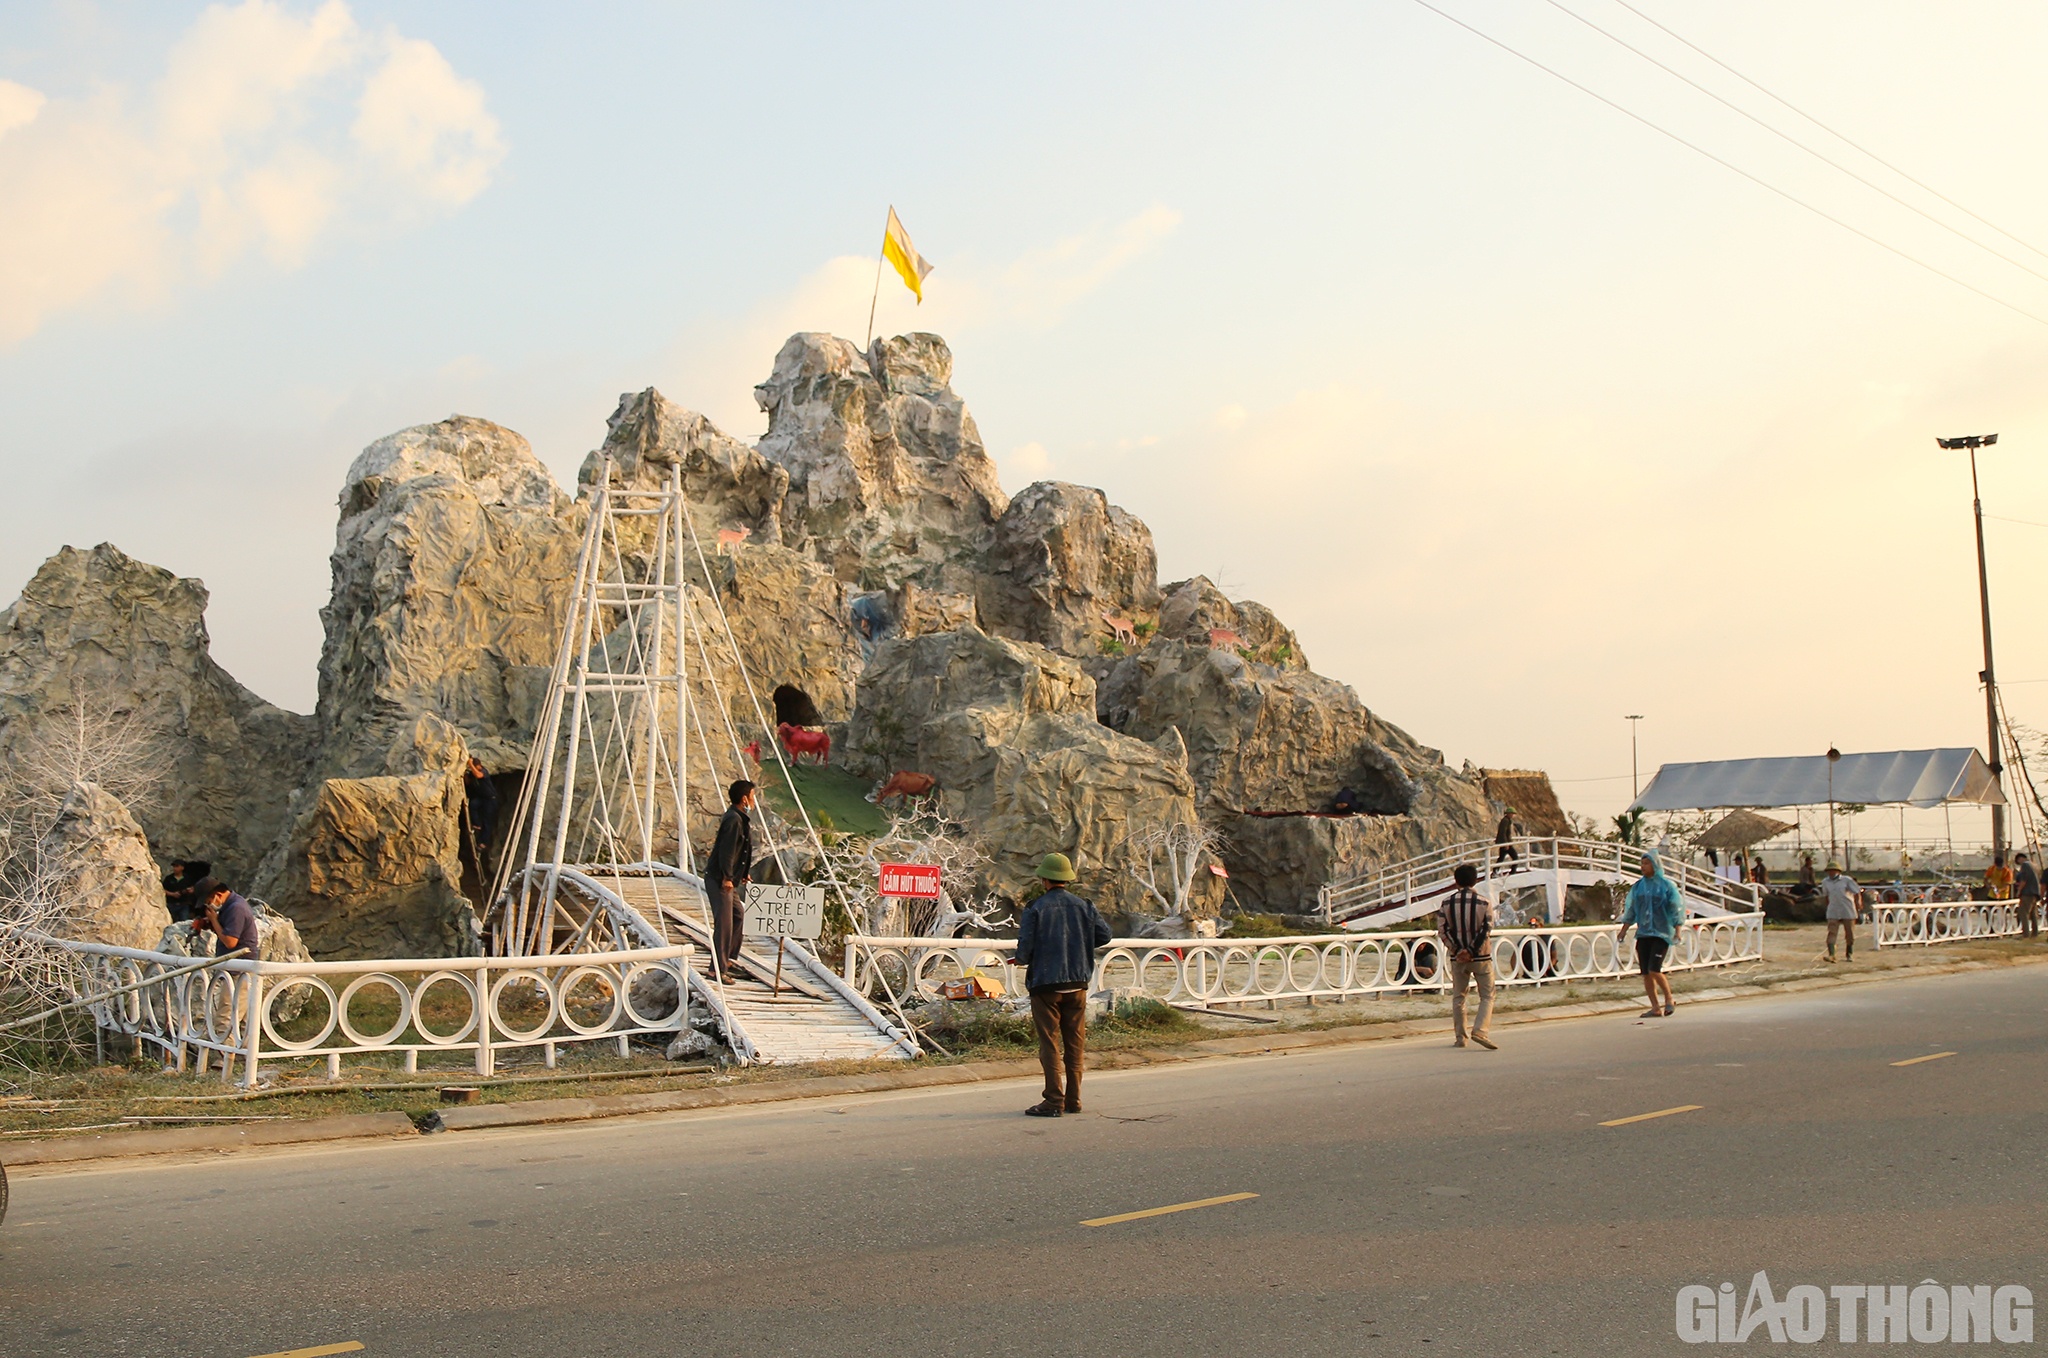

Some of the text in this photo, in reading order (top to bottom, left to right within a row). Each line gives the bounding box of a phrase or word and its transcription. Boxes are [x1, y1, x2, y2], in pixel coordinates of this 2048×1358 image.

[883, 868, 937, 894] CẤM HÚT THUỐC
[796, 902, 816, 916] EM
